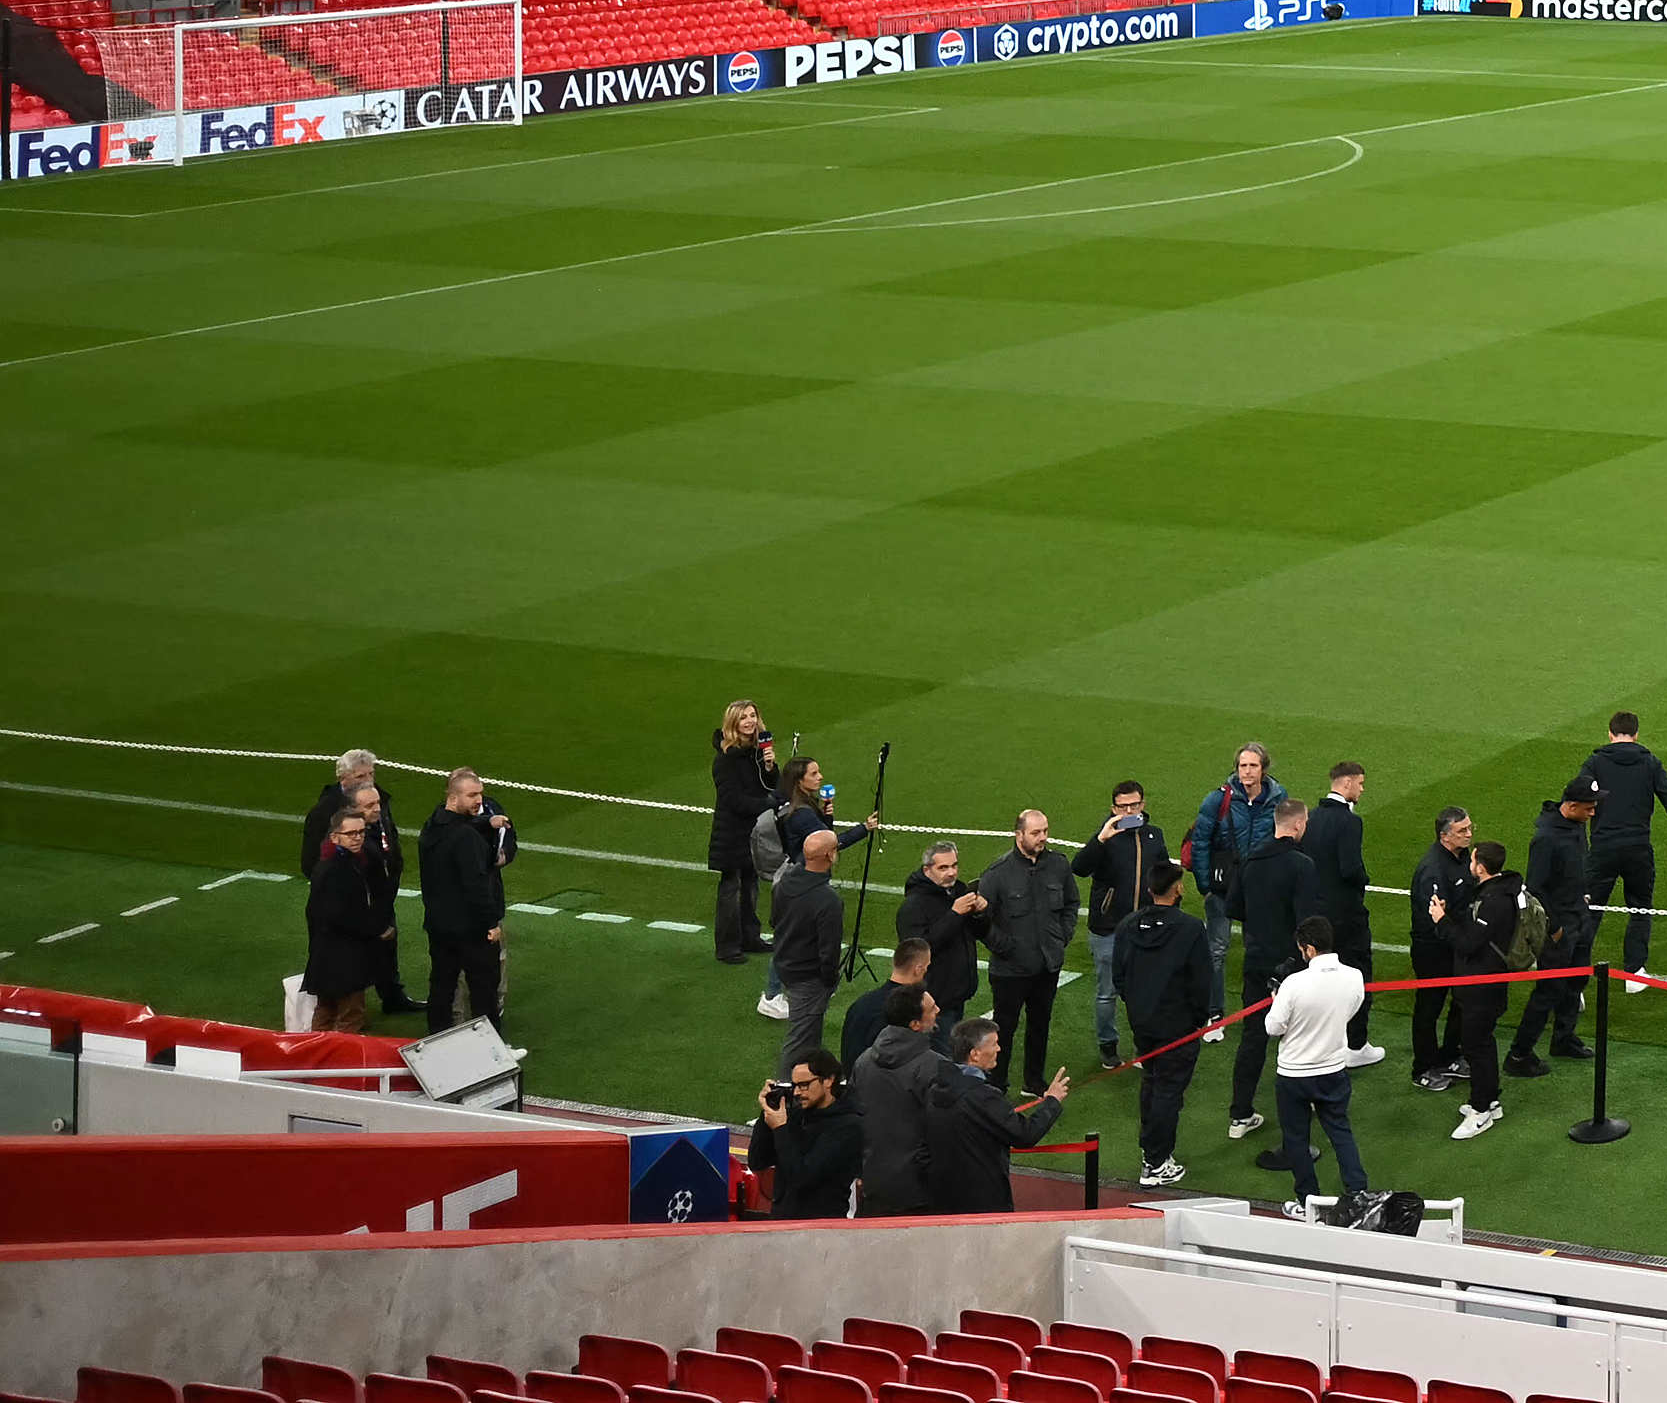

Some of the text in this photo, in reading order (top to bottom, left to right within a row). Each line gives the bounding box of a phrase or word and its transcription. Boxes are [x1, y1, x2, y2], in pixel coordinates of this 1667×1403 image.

[1026, 8, 1178, 54] crypto.com
[731, 67, 758, 77] PEPSI
[785, 34, 915, 87] PEPSI
[559, 60, 706, 112] AIRWAYS
[200, 105, 325, 154] FedEx
